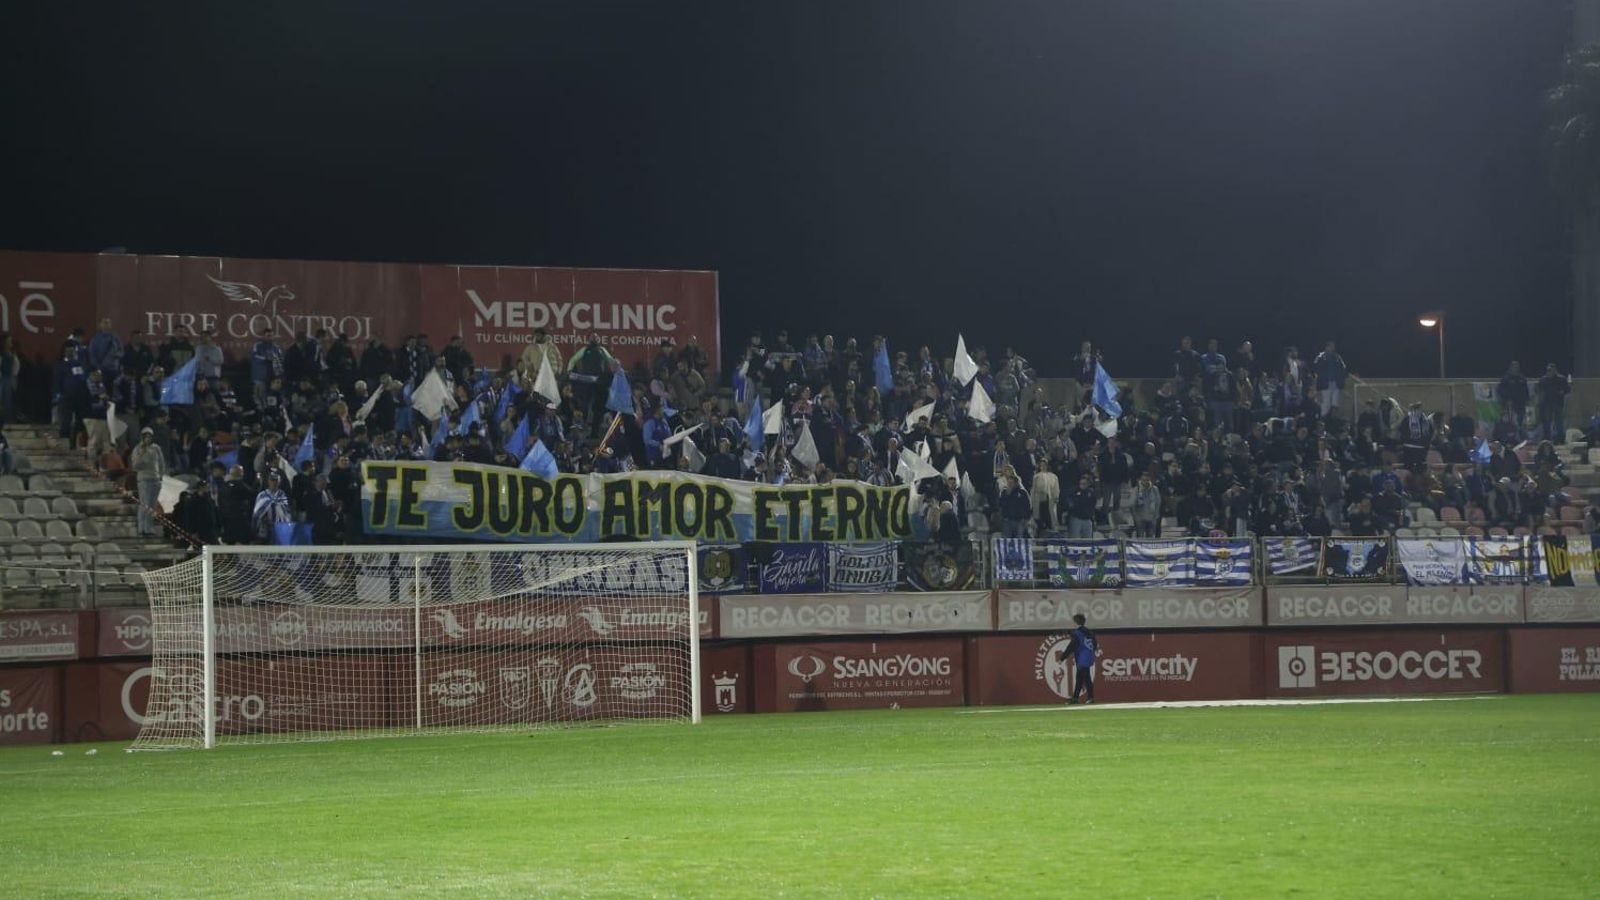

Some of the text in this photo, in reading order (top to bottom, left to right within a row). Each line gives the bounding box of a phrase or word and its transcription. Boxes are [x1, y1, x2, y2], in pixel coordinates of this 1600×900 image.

[466, 289, 677, 331] MEDYCLINIC
[145, 311, 218, 337] FIRE
[475, 333, 490, 343] TU
[366, 465, 912, 541] TE JURO AMOR ETERNO
[732, 604, 850, 629] RECACOR
[866, 602, 981, 625] RECACOR
[1009, 600, 1123, 622] RECACOR
[1138, 597, 1250, 620] RECACOR
[1279, 597, 1392, 619] RECACOR
[1406, 594, 1517, 616] RECACOR
[475, 611, 567, 635] Emalgesa
[620, 608, 708, 630] Emalgea
[833, 654, 950, 679] SSANGYONG
[1321, 650, 1482, 681] BESOCCER
[1561, 647, 1579, 663] EL
[1102, 654, 1198, 681] servicity
[833, 677, 951, 688] NUEVA GENERACIÓN
